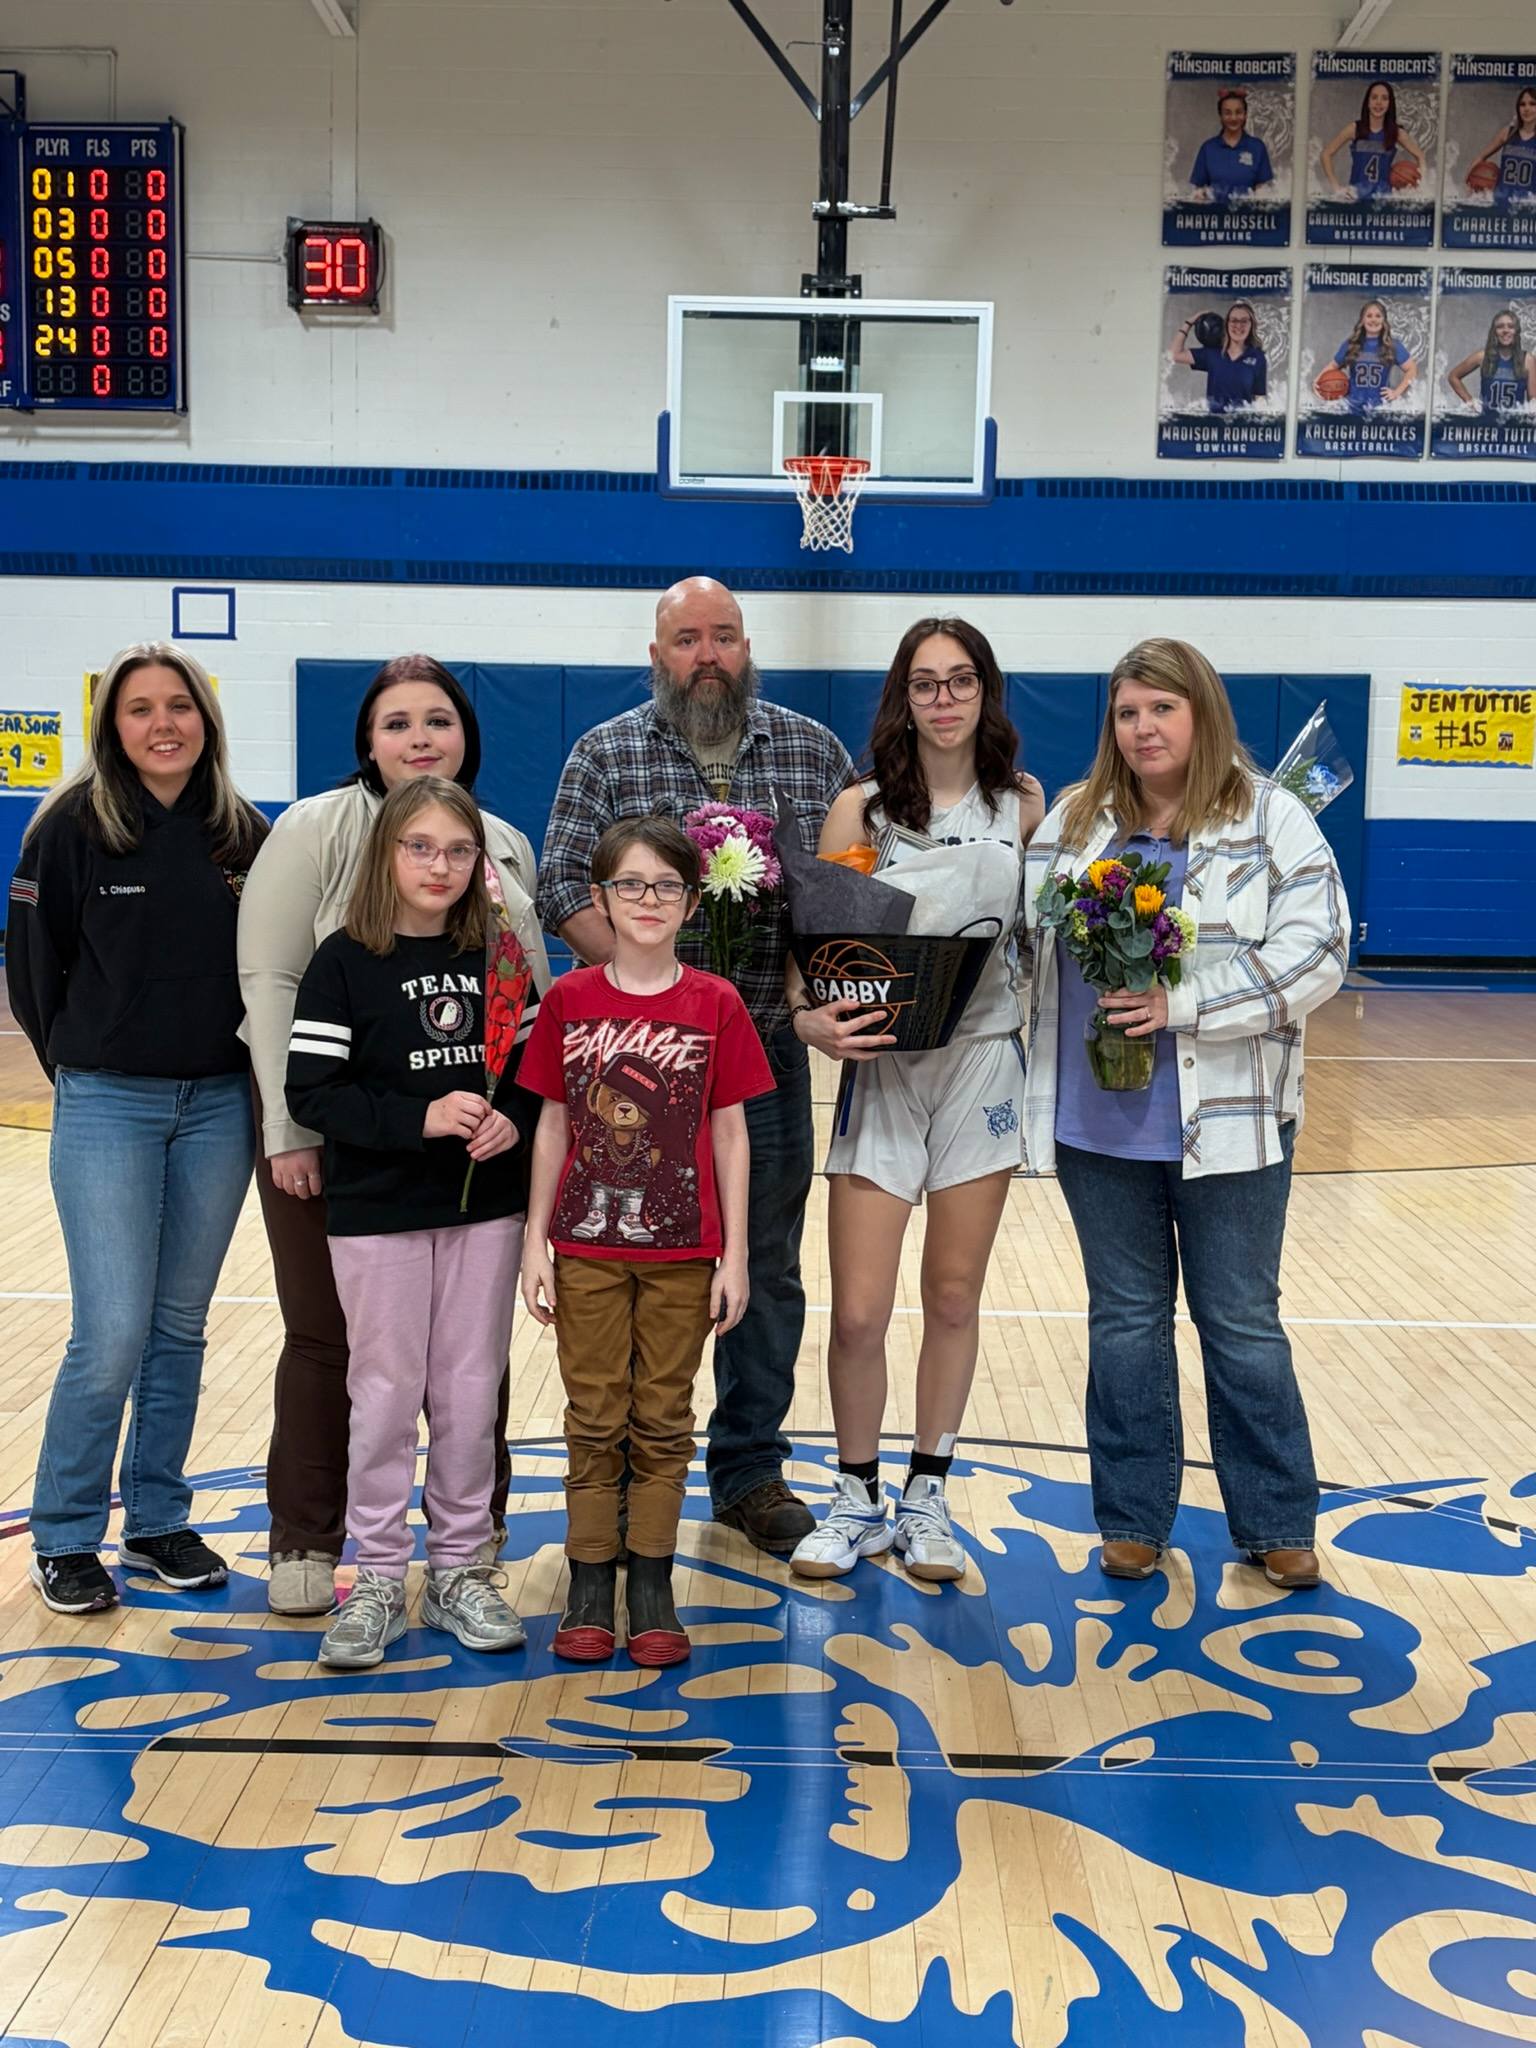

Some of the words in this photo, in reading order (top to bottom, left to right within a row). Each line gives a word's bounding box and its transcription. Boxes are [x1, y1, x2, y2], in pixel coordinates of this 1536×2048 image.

[1174, 59, 1231, 73] HINSDALE
[1235, 60, 1290, 74] BOBCATS
[1319, 58, 1377, 73] HINSDALE
[1380, 59, 1435, 73] BOBCATS
[1457, 61, 1514, 76] HINSDALE
[1518, 63, 1536, 77] BO
[36, 138, 69, 156] PLYR
[86, 139, 110, 157] FLS
[131, 139, 157, 157] PTS
[1364, 154, 1379, 183] 4
[1504, 158, 1532, 186] 20
[32, 168, 74, 200] 01
[90, 169, 108, 200] 0
[147, 170, 166, 201] 0
[33, 208, 75, 240] 03
[90, 208, 109, 240] 0
[147, 209, 166, 240] 0
[1176, 214, 1218, 229] AMAYA
[1224, 214, 1276, 230] RUSSELL
[1309, 213, 1362, 226] GABRIELLA
[1453, 217, 1507, 232] CHARLEE
[1513, 219, 1536, 233] BRI
[1200, 231, 1252, 241] BOWLING
[1334, 230, 1404, 241] BASKETBALL
[34, 247, 76, 279] 05
[91, 247, 109, 279] 0
[148, 248, 166, 280] 0
[304, 238, 367, 293] 30
[1172, 273, 1228, 288] HINSDALE
[1232, 274, 1287, 288] BOBCATS
[1312, 271, 1369, 286] HINSDALE
[1372, 273, 1427, 287] BOBCATS
[1445, 273, 1502, 288] HINSDALE
[46, 285, 76, 317] 13
[91, 286, 110, 317] 0
[148, 287, 167, 318] 0
[35, 324, 77, 356] 24
[92, 325, 110, 356] 0
[149, 326, 167, 357] 0
[93, 364, 111, 396] 0
[1355, 362, 1383, 388] 25
[1488, 380, 1518, 409] 15
[1162, 426, 1218, 441] MADISON
[1224, 427, 1281, 442] RONDEAU
[1305, 424, 1356, 440] KALEIGH
[1362, 425, 1416, 441] BUCKLES
[1441, 426, 1498, 442] JENNIFER
[1195, 443, 1247, 453] BOWLING
[1325, 441, 1394, 452] BASKETBALL
[1458, 442, 1528, 454] BASKETBALL
[1434, 720, 1487, 749] #15
[401, 973, 483, 1000] TEAM
[813, 978, 891, 1004] GABBY
[563, 1018, 716, 1071] SAVAGE
